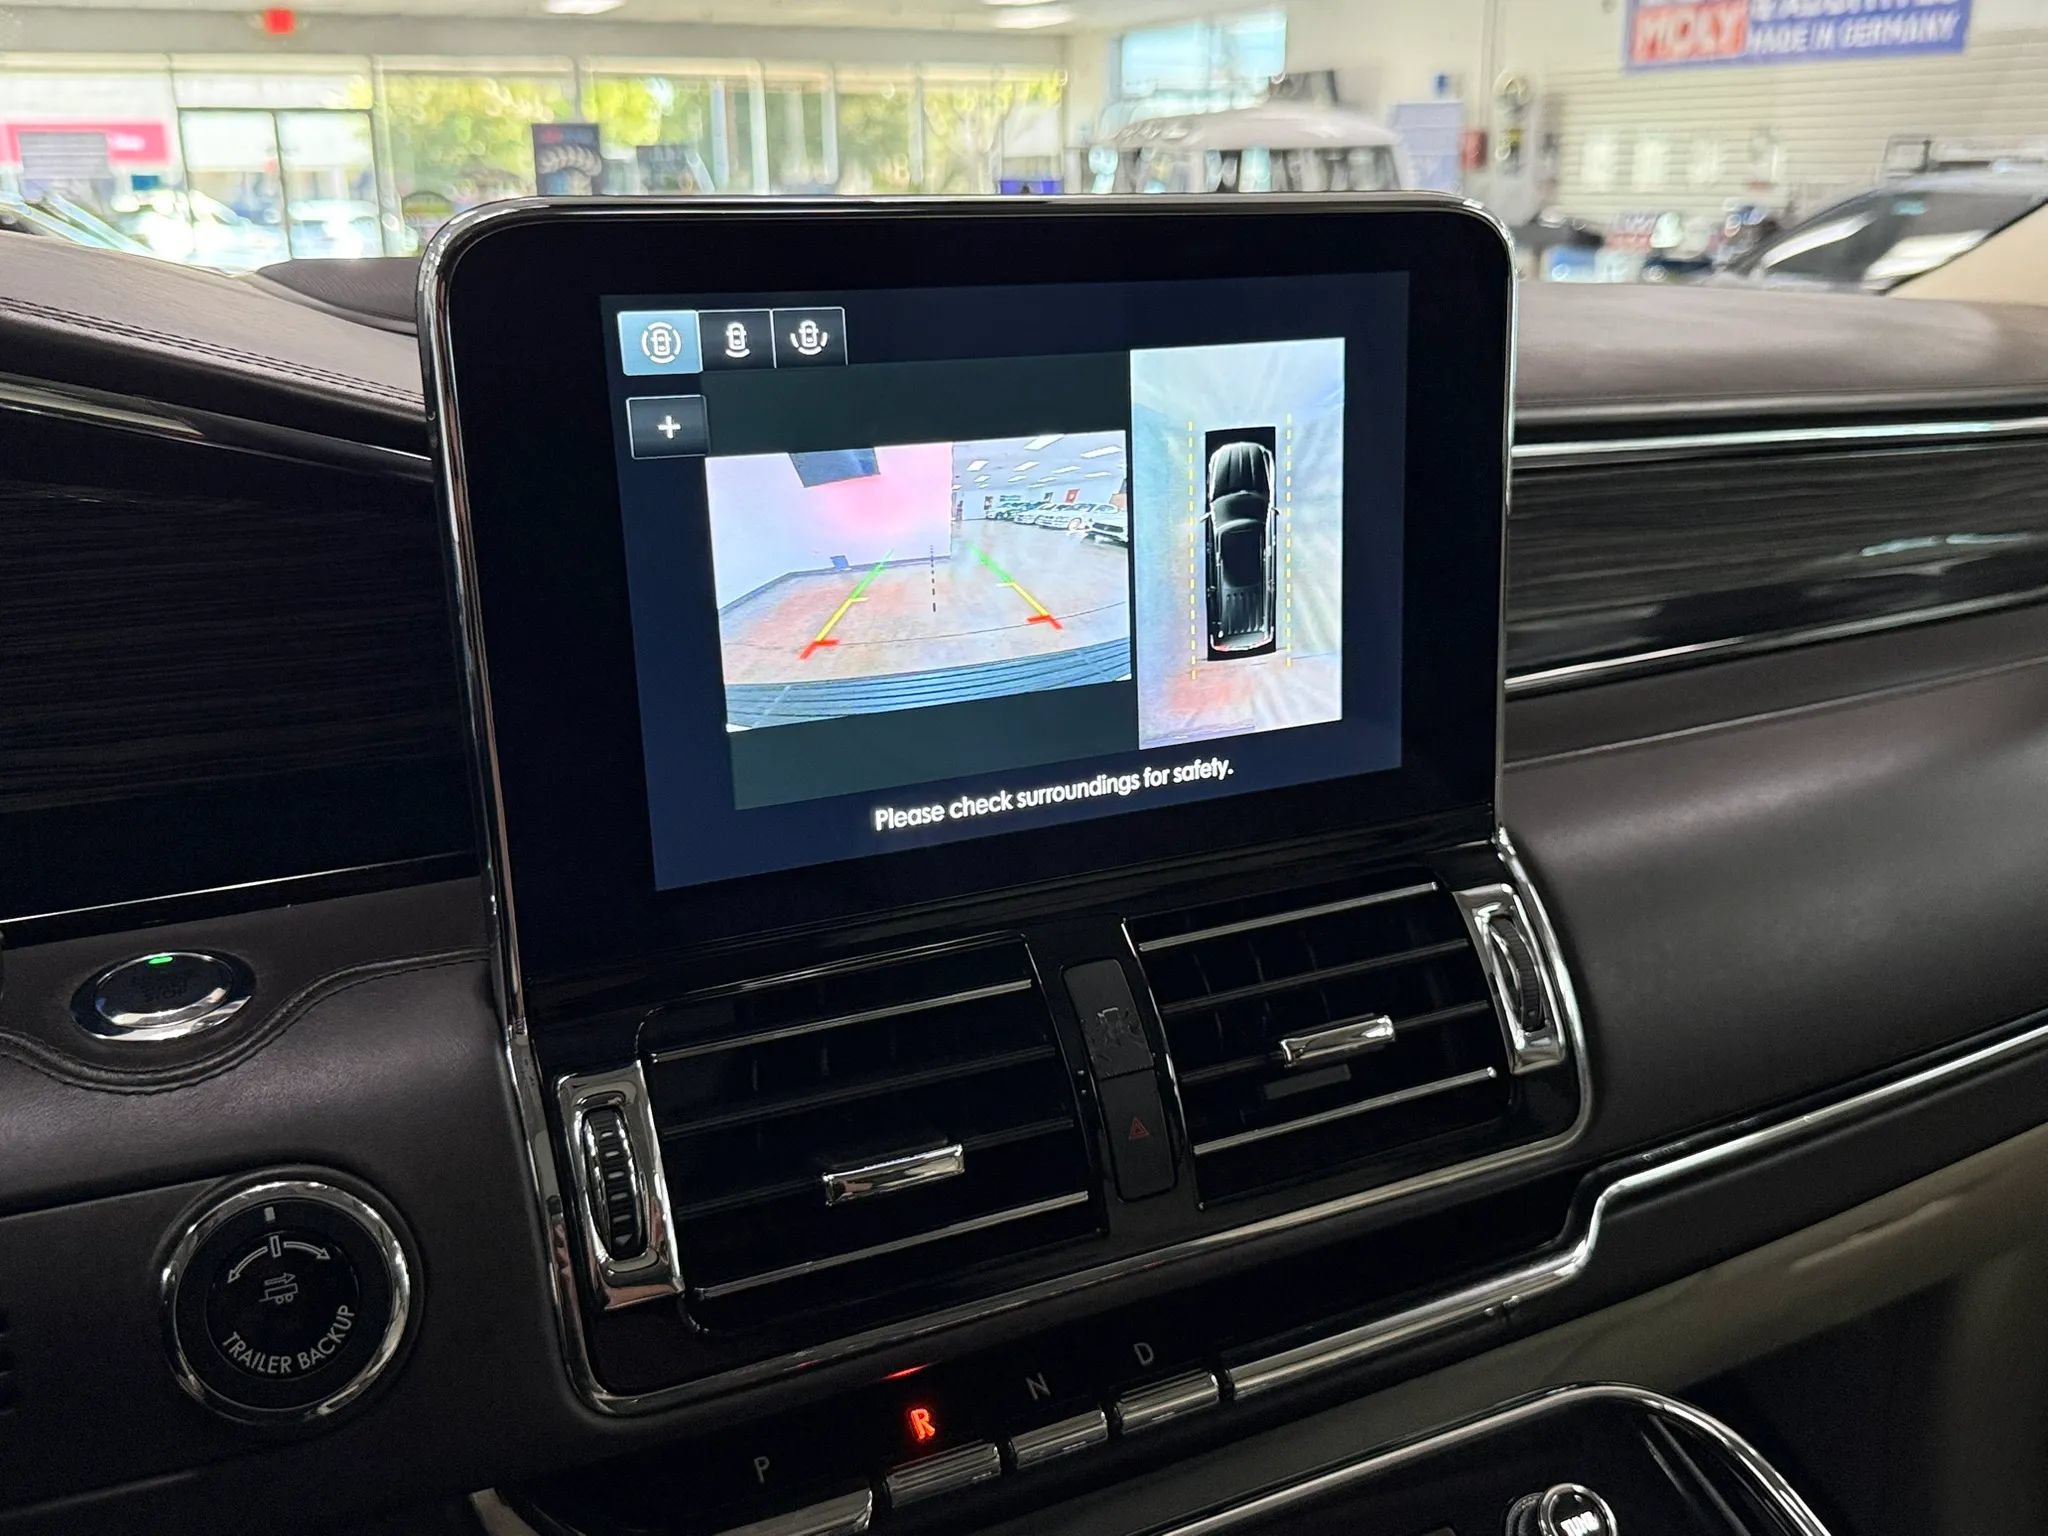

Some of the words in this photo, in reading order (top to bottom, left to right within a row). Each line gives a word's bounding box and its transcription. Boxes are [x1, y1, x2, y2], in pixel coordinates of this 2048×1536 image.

[1636, 5, 1746, 59] MOLY
[1750, 27, 1808, 54] MADE
[1811, 23, 1835, 51] IN
[1842, 12, 1959, 47] GERMANY
[875, 806, 945, 831] Please
[949, 790, 1014, 819] check
[1016, 770, 1141, 809] surroundings
[1143, 766, 1170, 789] for
[1172, 757, 1234, 784] safety.
[222, 1332, 292, 1374] TRAILER
[297, 1304, 355, 1370] BACKUP
[753, 1456, 770, 1483] P
[909, 1407, 936, 1440] R
[1025, 1372, 1051, 1400] N
[1133, 1342, 1154, 1366] D
